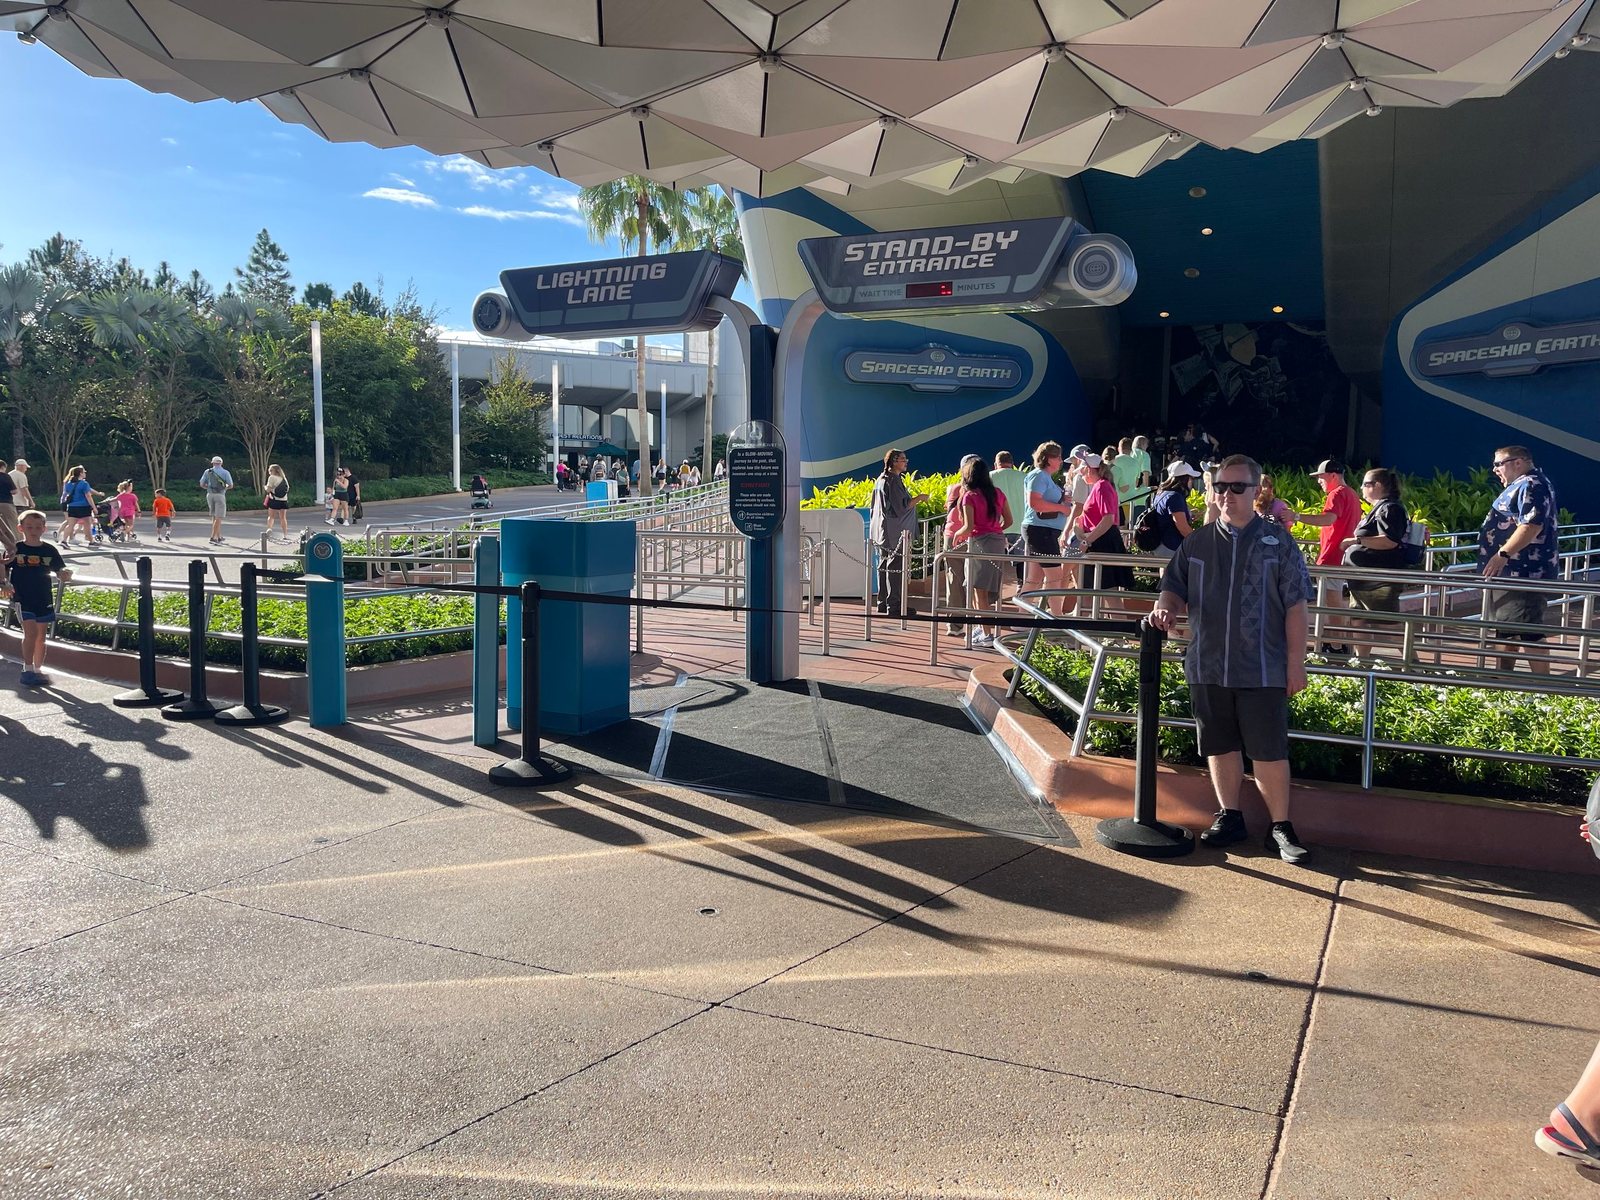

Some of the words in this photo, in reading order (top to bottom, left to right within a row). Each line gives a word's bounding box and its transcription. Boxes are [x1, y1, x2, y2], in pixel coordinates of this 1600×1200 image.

[844, 230, 1019, 262] STAND-BY
[536, 262, 667, 290] LIGHTNING
[863, 252, 997, 276] ENTRANCE
[567, 283, 634, 305] LANE
[859, 290, 881, 298] WAIT
[881, 288, 902, 297] TIME
[957, 282, 996, 292] MINUTES
[1428, 342, 1532, 367] SPACESHIP
[860, 361, 954, 376] SPACESHIP
[956, 366, 1012, 379] EARTH
